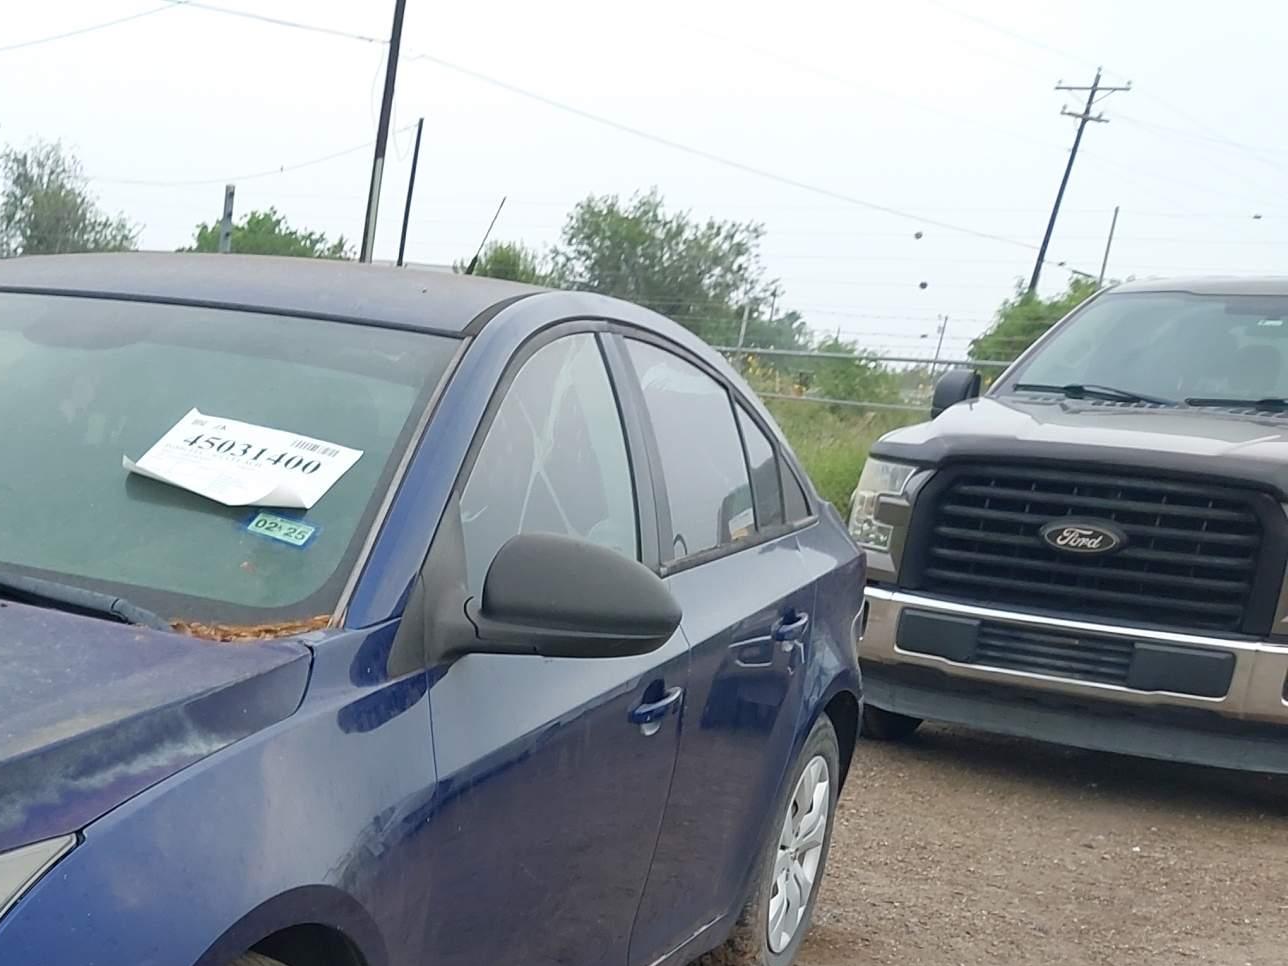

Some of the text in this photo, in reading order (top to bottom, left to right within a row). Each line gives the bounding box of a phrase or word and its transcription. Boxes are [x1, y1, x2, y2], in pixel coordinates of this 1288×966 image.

[183, 433, 322, 476] 45031400
[255, 518, 307, 541] 02 25
[1056, 528, 1104, 548] Ford
